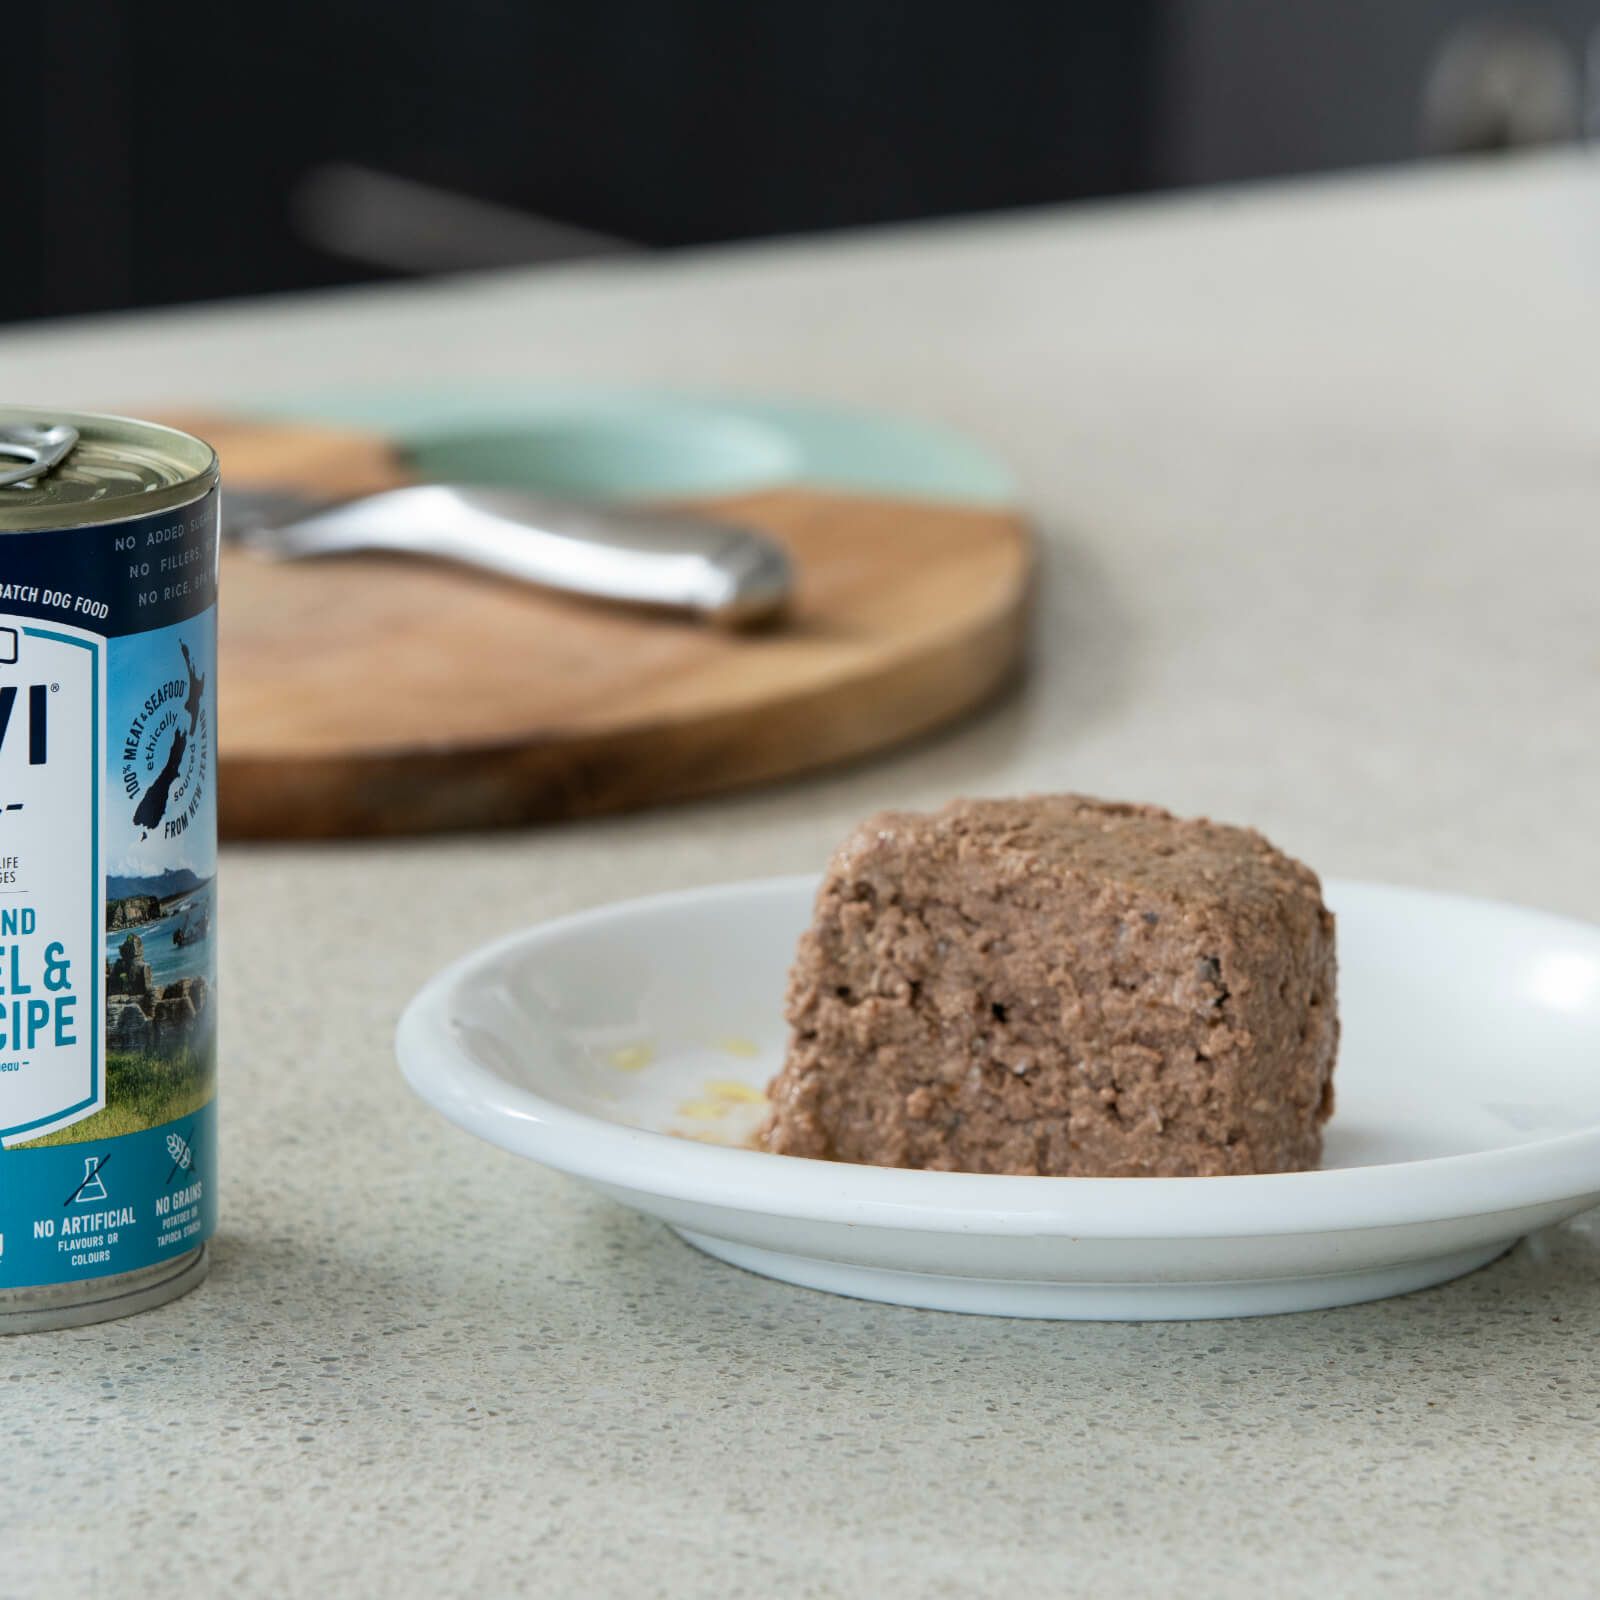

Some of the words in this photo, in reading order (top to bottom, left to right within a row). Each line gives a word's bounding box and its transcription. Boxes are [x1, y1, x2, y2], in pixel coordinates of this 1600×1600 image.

[115, 535, 137, 551] NO
[146, 524, 185, 546] ADDED
[129, 563, 150, 578] NO
[42, 589, 72, 609] DOG
[74, 596, 109, 619] FOOD
[138, 590, 158, 607] NO
[140, 712, 148, 722] &
[123, 717, 145, 761] MEAT
[145, 710, 178, 771] ethically
[122, 763, 140, 800] 100%
[173, 743, 196, 802] sourced
[164, 811, 189, 839] FROM
[188, 783, 203, 818] NEW
[1, 908, 36, 936] ND
[0, 945, 31, 995] L
[43, 941, 72, 992] &
[0, 1060, 20, 1072] eau
[155, 1196, 170, 1217] NO
[172, 1181, 202, 1211] GRAINS
[33, 1219, 55, 1239] NO
[61, 1206, 136, 1236] ARTIFICIAL
[58, 1235, 104, 1252] FLAVOURS
[107, 1232, 119, 1245] OR
[71, 1250, 111, 1266] COLOURS
